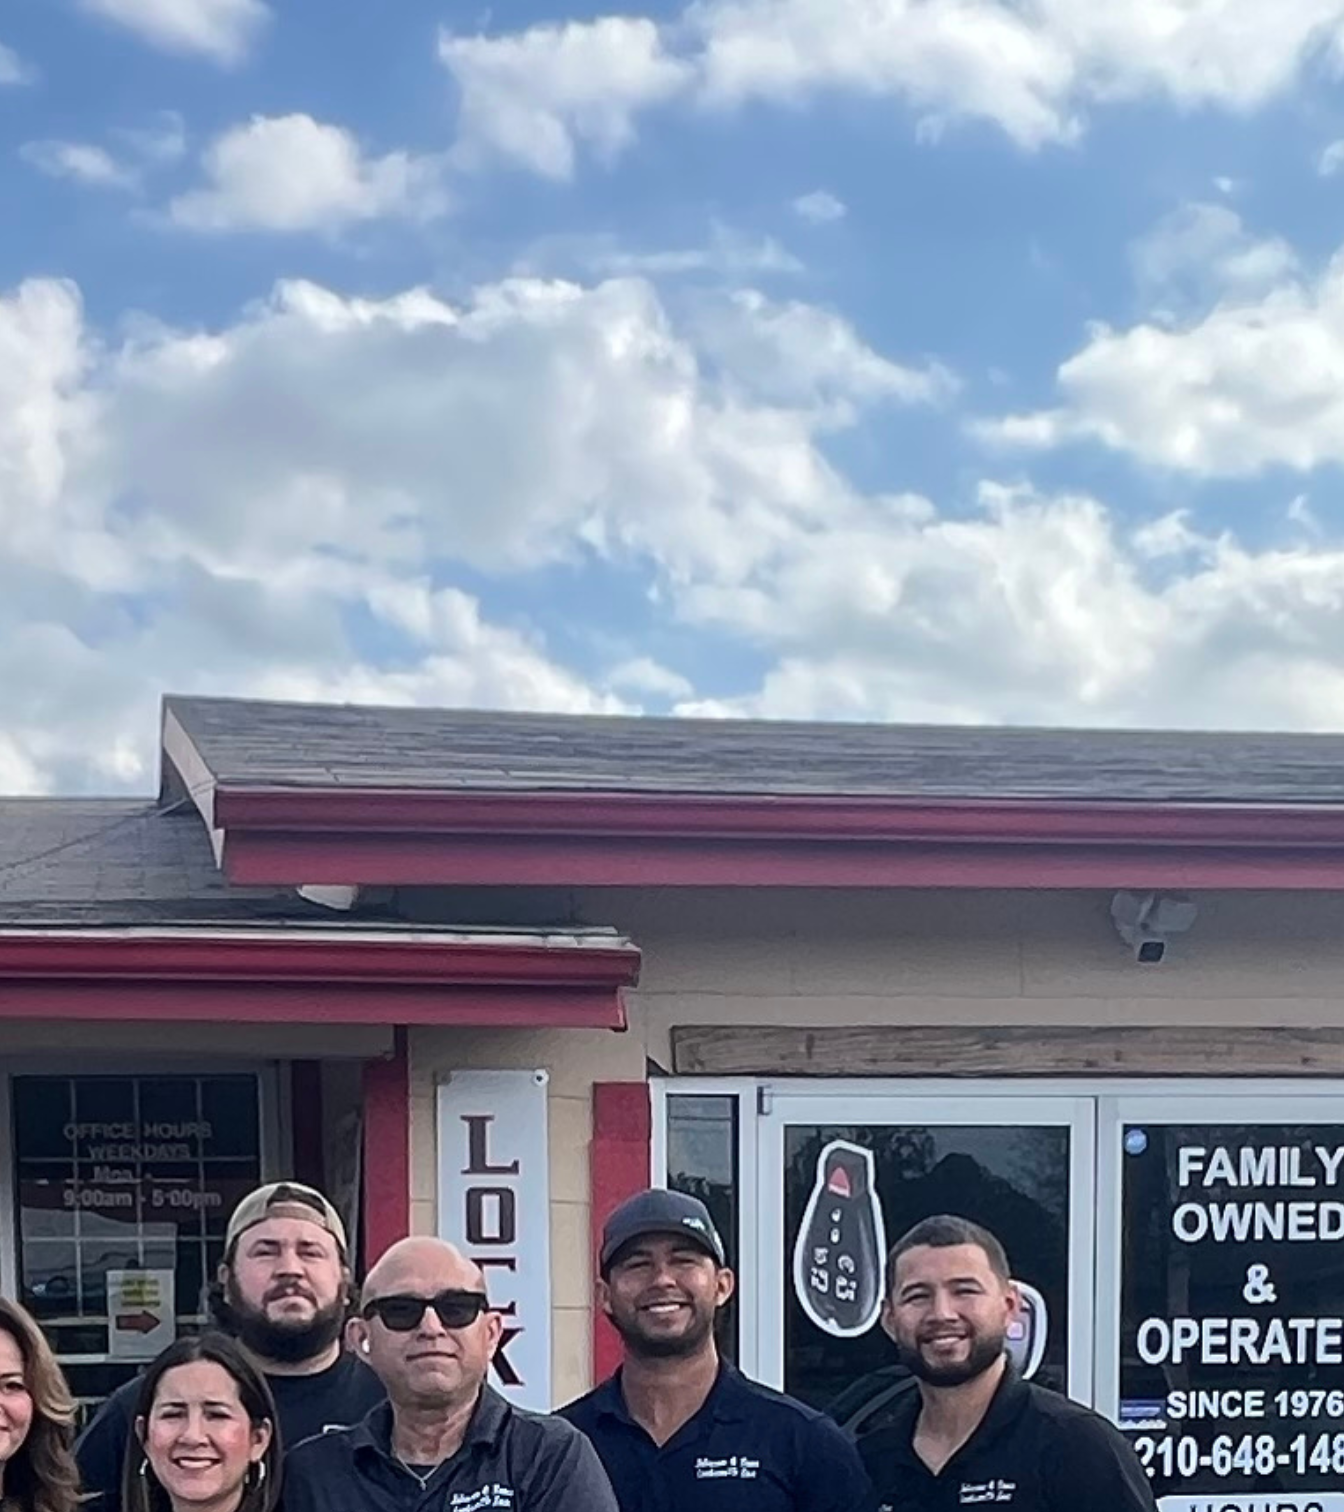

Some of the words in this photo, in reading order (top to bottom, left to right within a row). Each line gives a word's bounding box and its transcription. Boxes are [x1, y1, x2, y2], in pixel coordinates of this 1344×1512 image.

[63, 1123, 135, 1140] OFFICE
[143, 1122, 212, 1139] HOURS
[87, 1143, 191, 1161] WEEKDAYS
[62, 1189, 133, 1207] 9:00am
[152, 1189, 222, 1210] 5:00pm
[1242, 1263, 1277, 1304] &
[1166, 1390, 1265, 1419] SINCE
[1274, 1391, 1344, 1417] 1976
